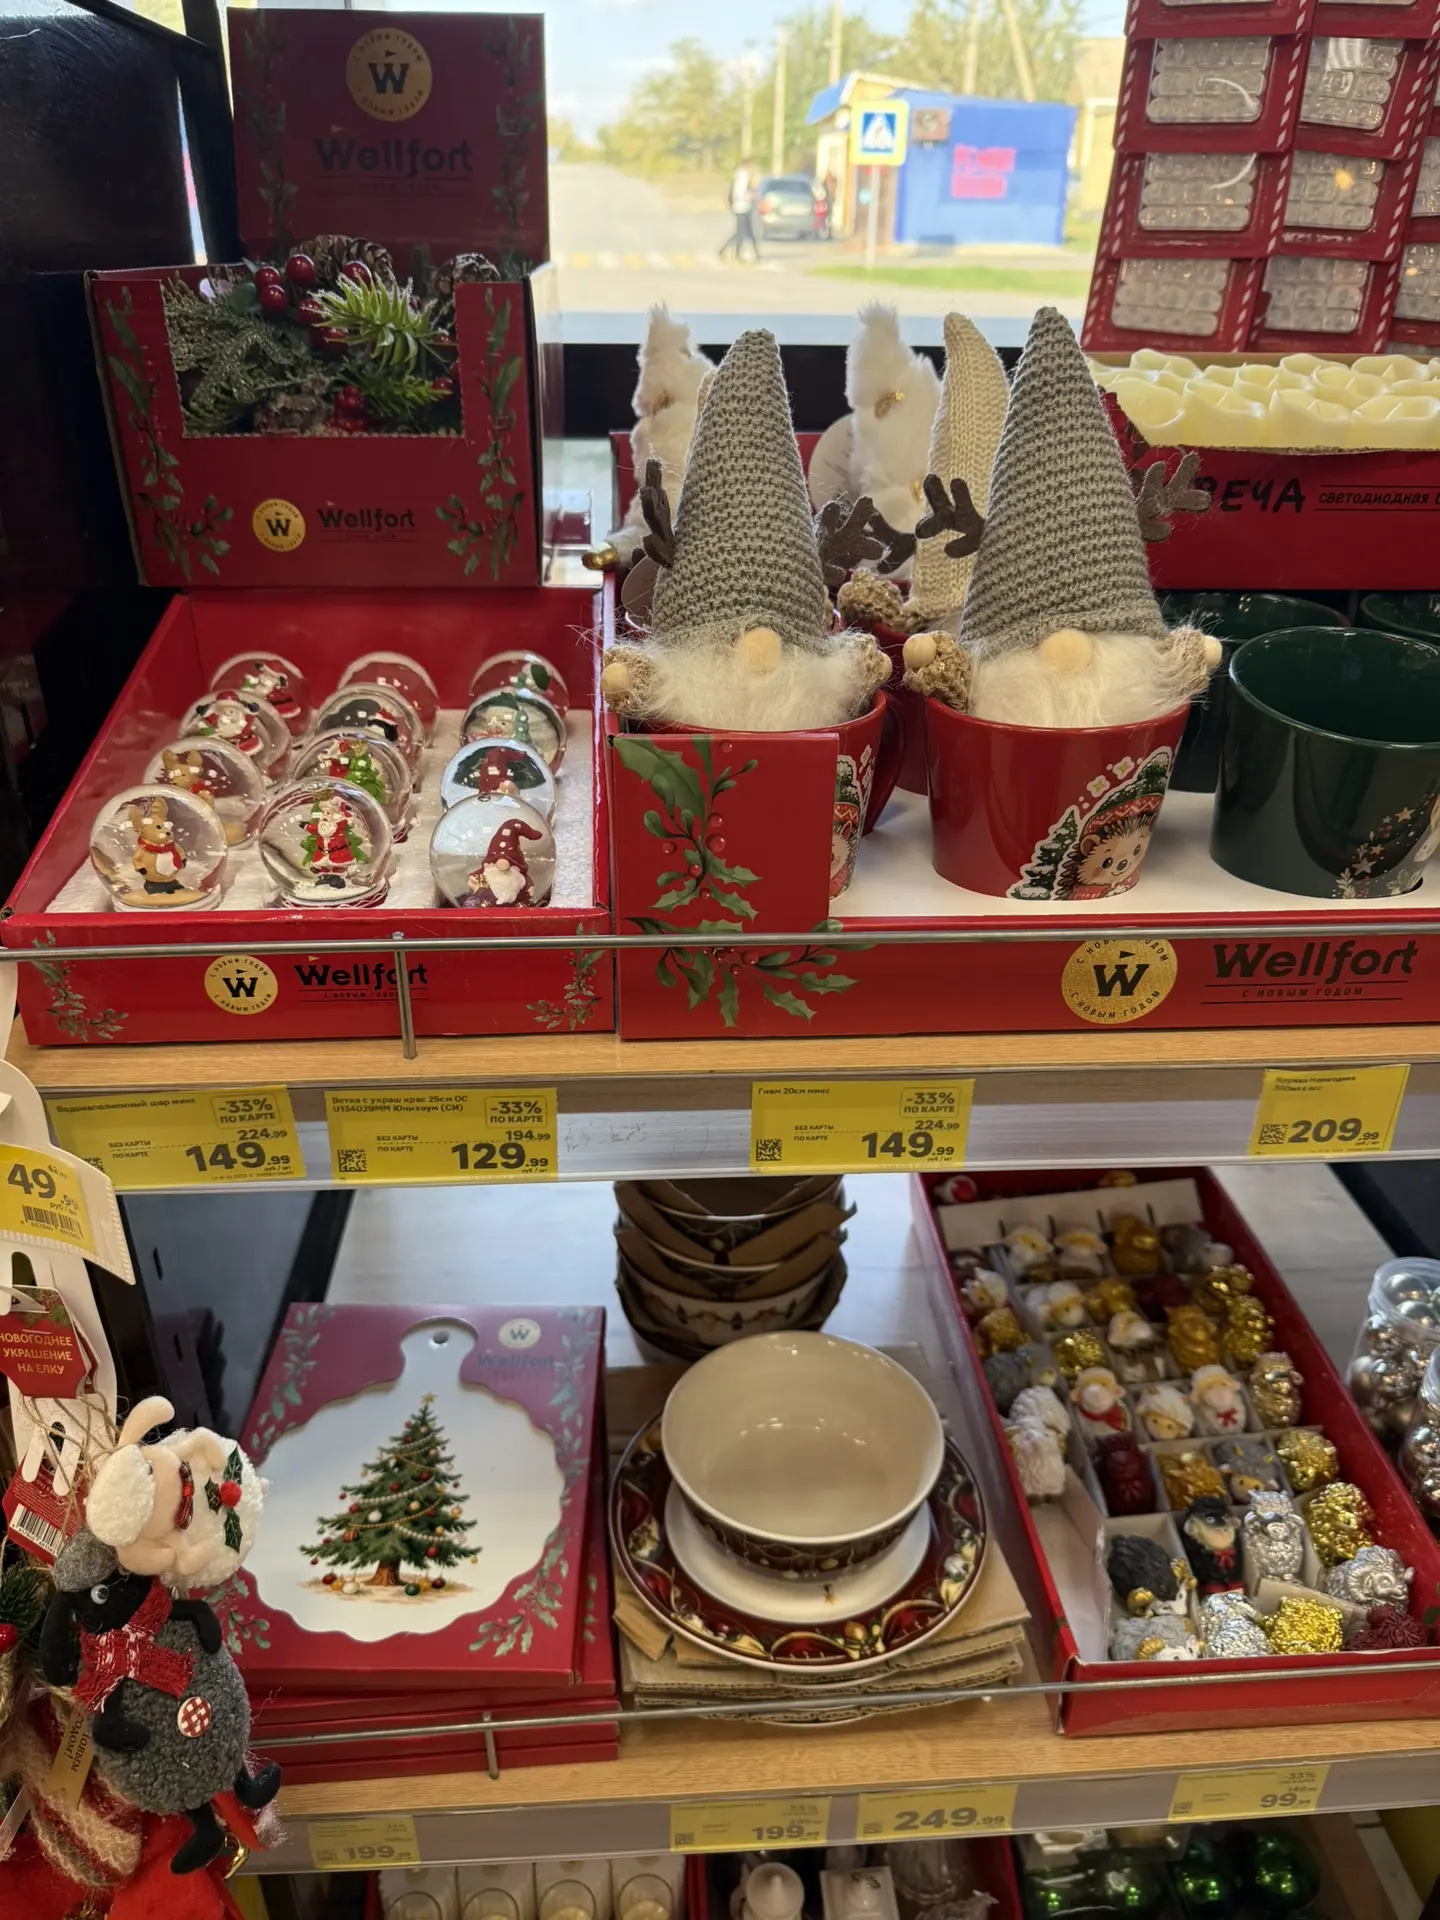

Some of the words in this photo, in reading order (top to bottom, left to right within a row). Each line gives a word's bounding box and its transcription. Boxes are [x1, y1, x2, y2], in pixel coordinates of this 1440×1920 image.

[369, 62, 410, 95] W
[314, 137, 473, 176] Wellfort
[1318, 492, 1431, 506] светодиодная
[317, 508, 416, 532] Wellfort
[265, 519, 292, 537] W
[1212, 939, 1418, 985] Wellfort
[1093, 964, 1150, 997] W
[222, 977, 260, 999] W
[1257, 988, 1308, 997] НОВЫМ
[1315, 987, 1363, 997] ГОДОМ
[1076, 1001, 1118, 1019] НОВЫМ
[1123, 990, 1161, 1017] ГОДОМ
[758, 1087, 782, 1095] Гном
[783, 1087, 806, 1095] 20см
[149, 1099, 170, 1109] шар
[332, 1096, 361, 1104] Ветка
[370, 1097, 402, 1106] украш
[428, 1095, 453, 1103] 25см
[906, 1092, 956, 1105] -33%
[219, 1098, 273, 1114] -33%
[393, 1104, 439, 1113] Юнихоум
[440, 1104, 464, 1113] (СИ)
[491, 1101, 542, 1114] -33%
[904, 1106, 920, 1114] ПО
[921, 1105, 955, 1113] КАРТЕ
[220, 1114, 238, 1123] ПО
[239, 1112, 276, 1122] КАРТЕ
[490, 1115, 506, 1124] ПО
[507, 1114, 543, 1123] КАРТЕ
[127, 1139, 151, 1147] КАРТЫ
[3, 1347, 73, 1361] УКРАШЕНИЕ
[17, 1363, 34, 1373] НА
[36, 1364, 65, 1375] ЕЛКУ
